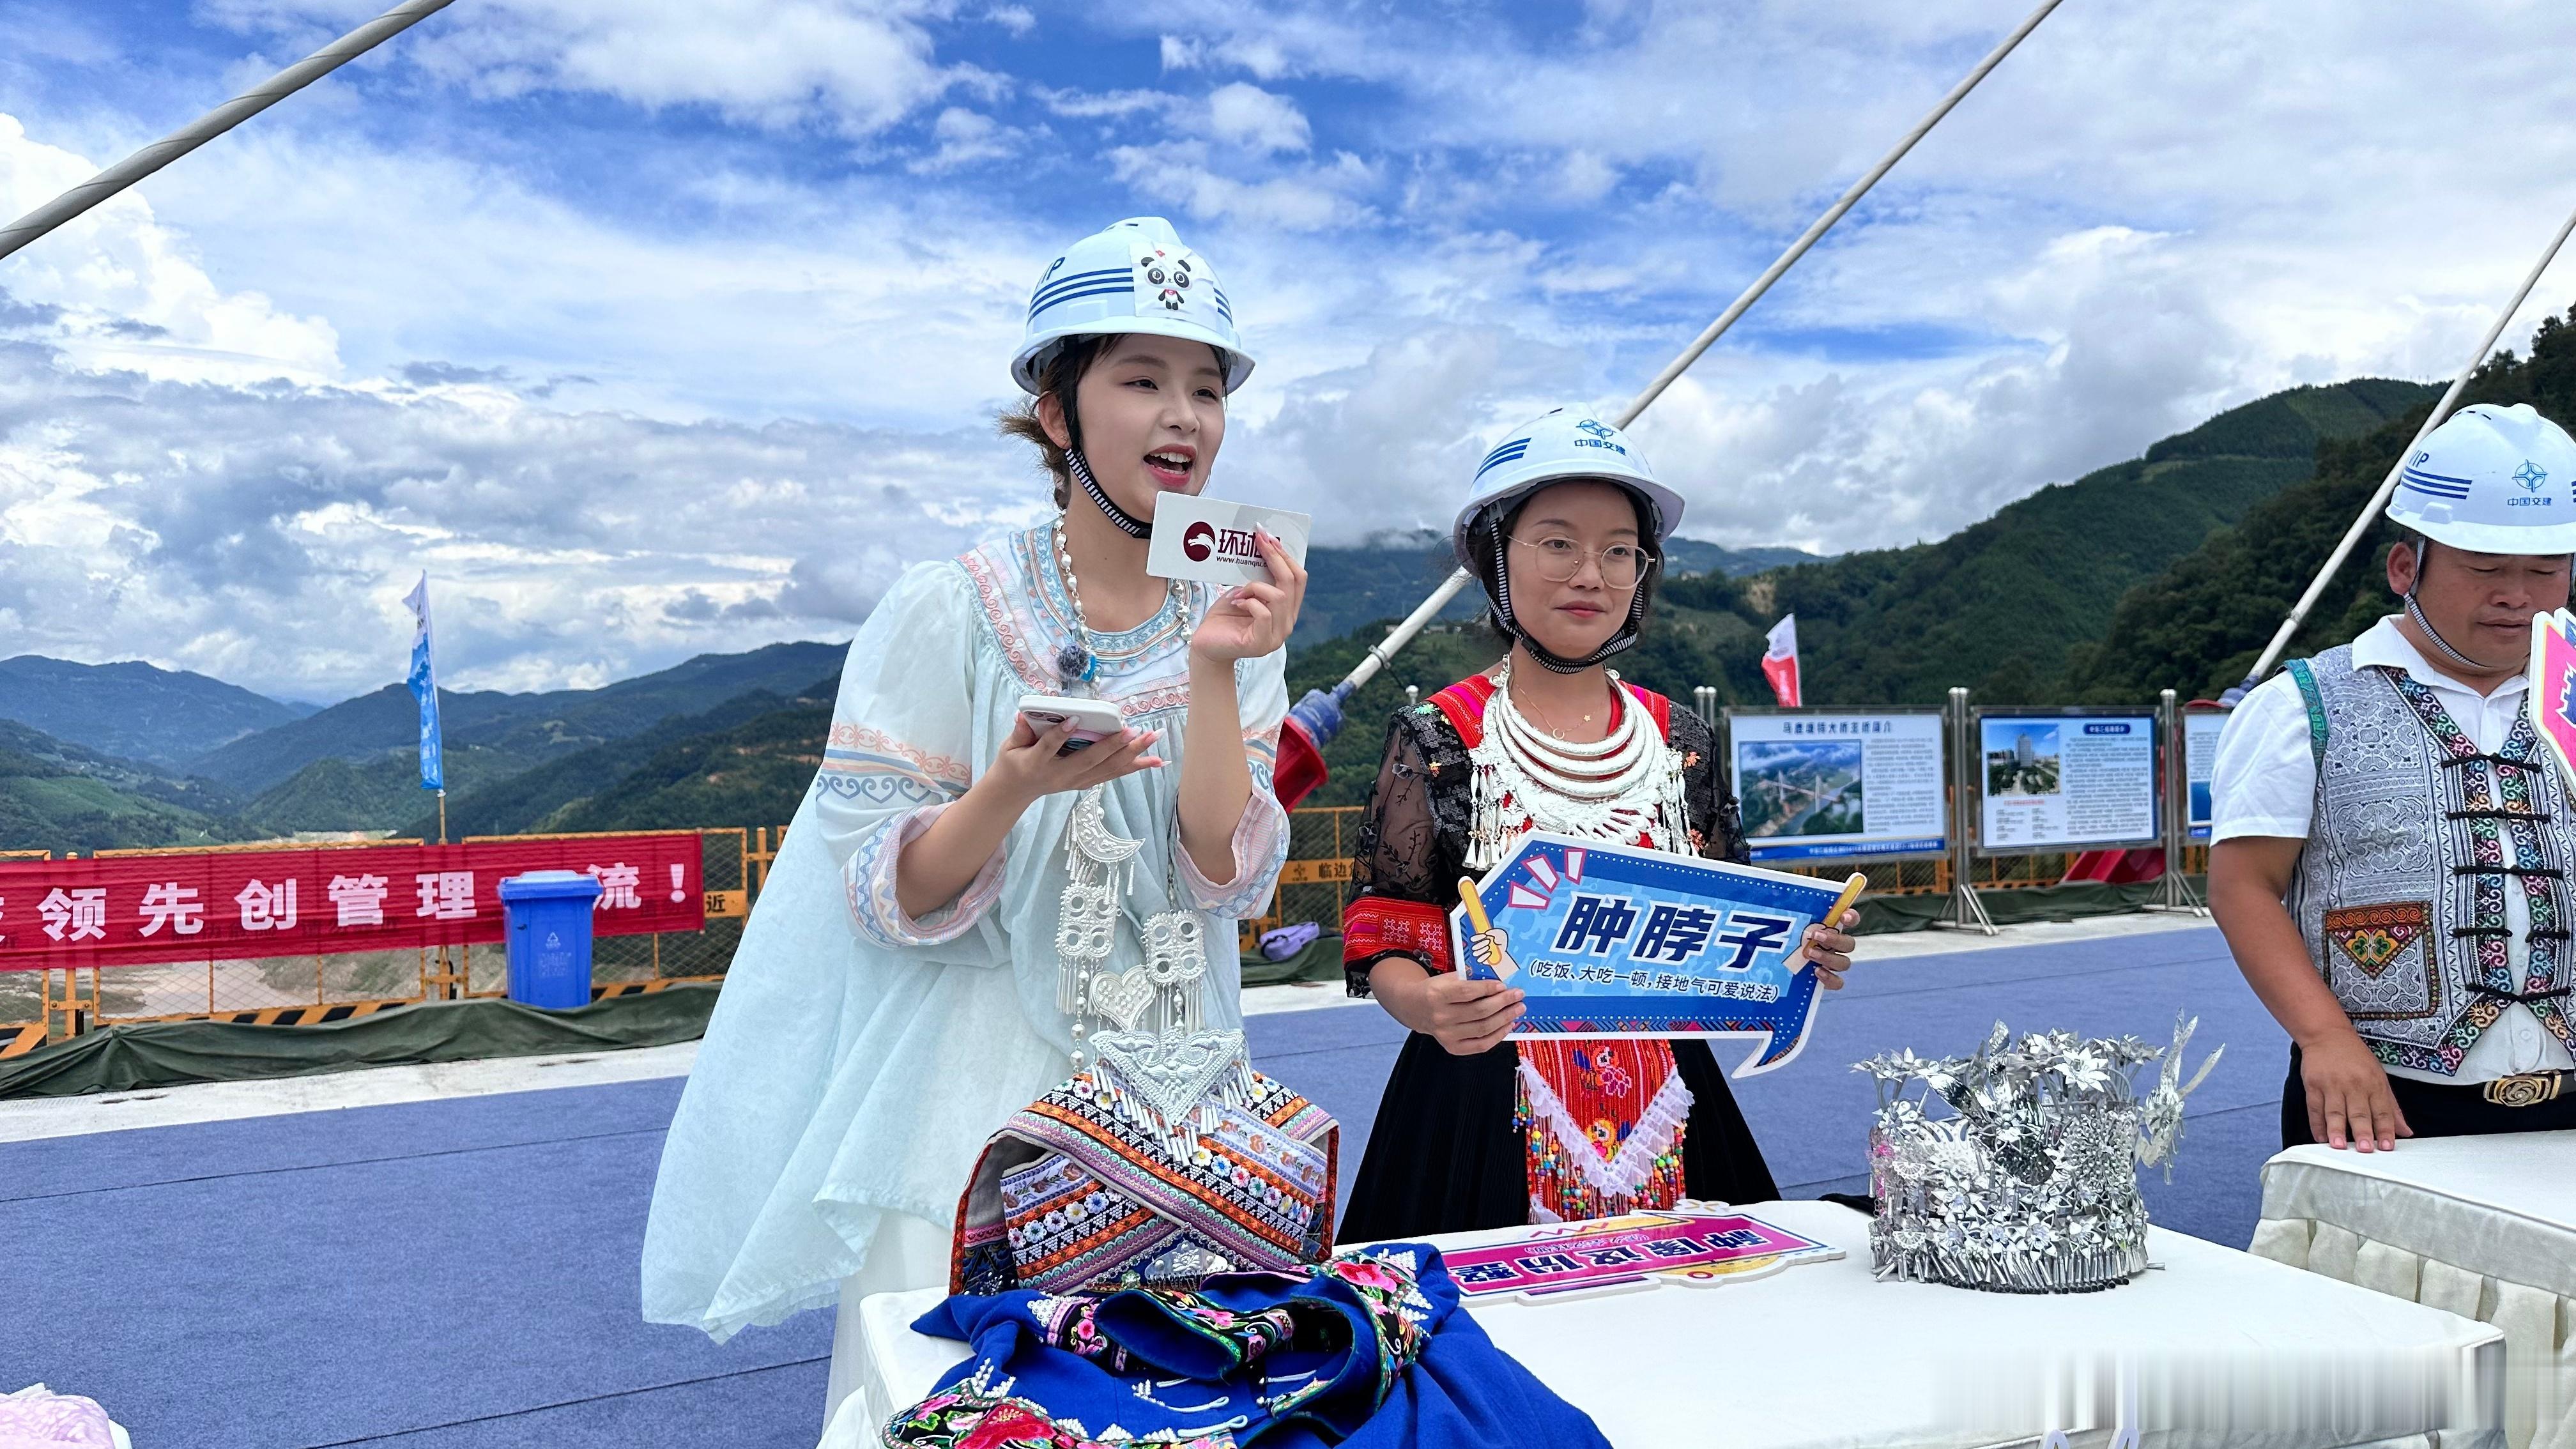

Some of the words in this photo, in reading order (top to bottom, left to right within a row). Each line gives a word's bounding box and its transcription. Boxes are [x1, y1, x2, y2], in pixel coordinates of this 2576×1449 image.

[1574, 439, 1627, 456] 中国交建
[2507, 497, 2552, 507] 中国交建
[1217, 528, 1280, 558] 环球
[0, 862, 687, 943] 领先创管理流！
[706, 894, 726, 913] 近
[1556, 896, 1790, 969] 肿脖子
[1529, 959, 1780, 1002] （吃饭、大吃一顿，接地气可爱说法）
